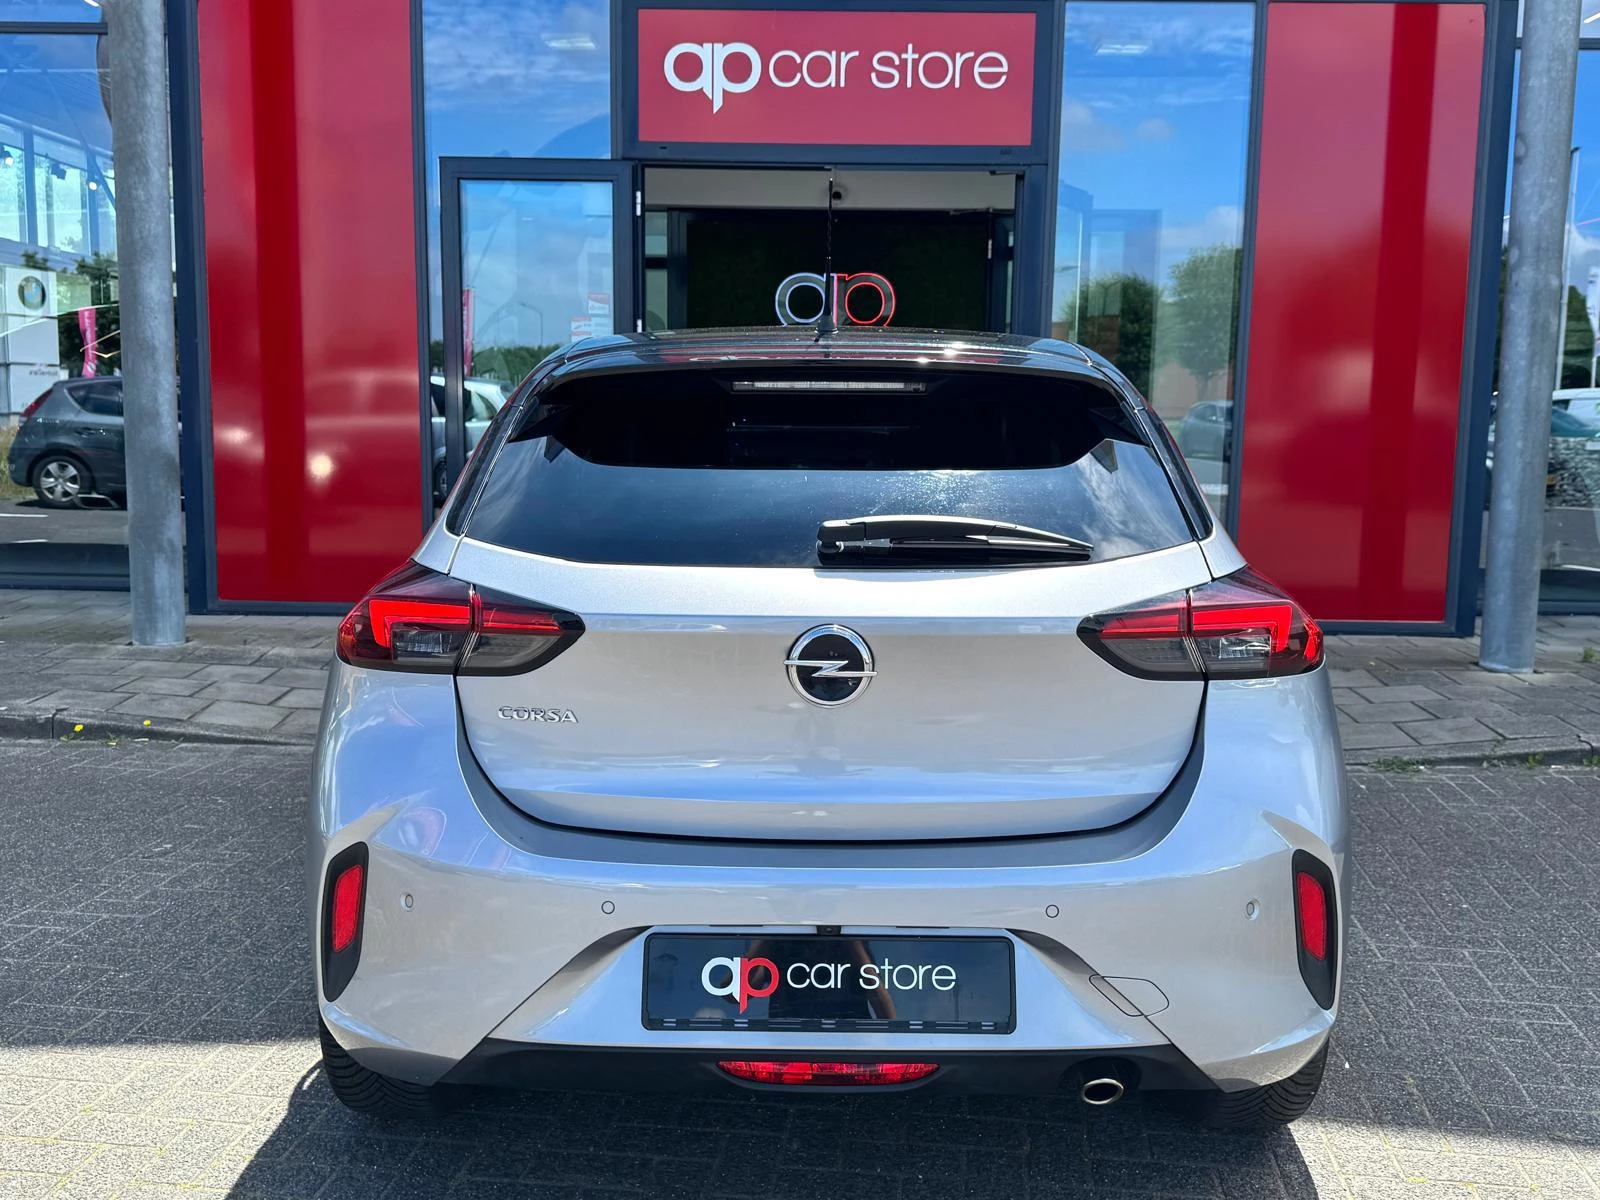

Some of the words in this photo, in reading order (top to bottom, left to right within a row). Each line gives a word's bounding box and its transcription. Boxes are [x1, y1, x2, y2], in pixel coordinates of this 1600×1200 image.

[663, 42, 762, 114] ap
[768, 49, 860, 88] car
[870, 43, 1009, 89] store
[498, 705, 579, 723] CORSA
[701, 956, 780, 1014] ap
[786, 962, 851, 989] car
[858, 957, 957, 991] store
